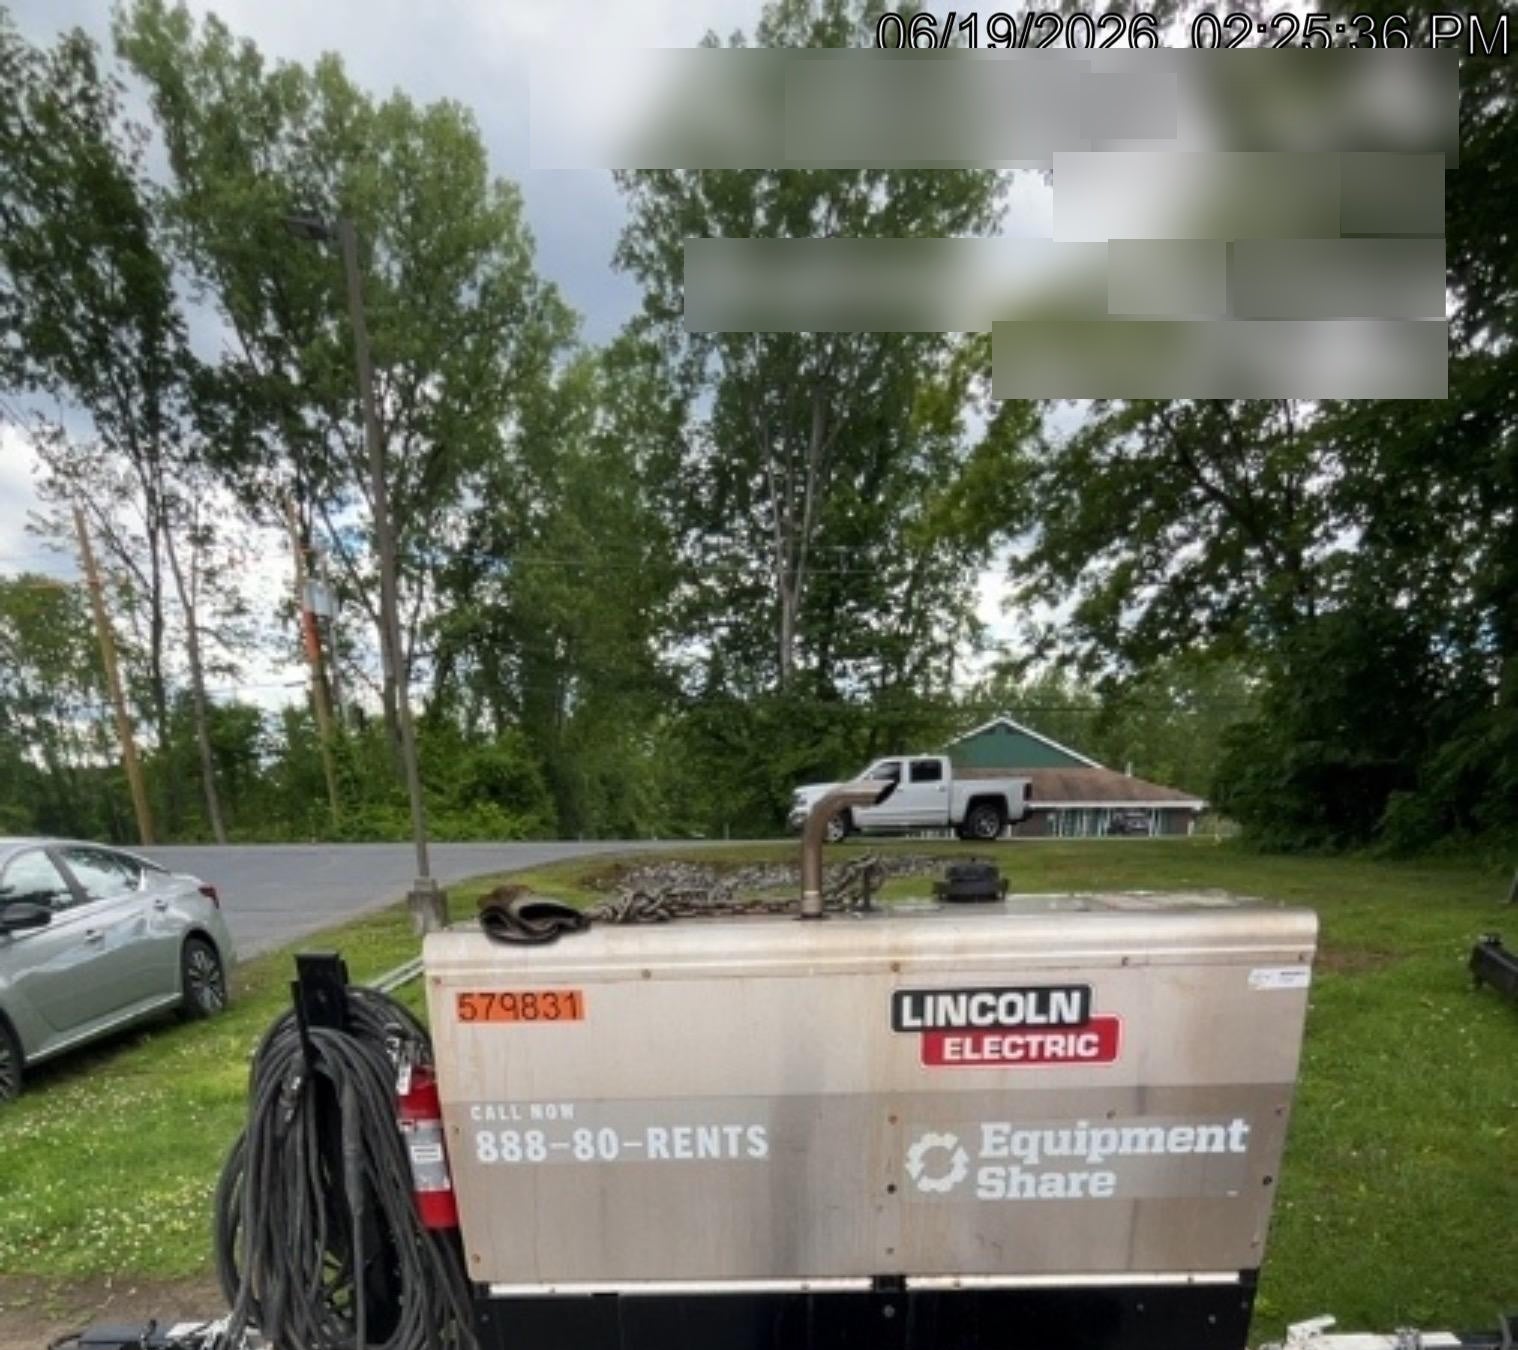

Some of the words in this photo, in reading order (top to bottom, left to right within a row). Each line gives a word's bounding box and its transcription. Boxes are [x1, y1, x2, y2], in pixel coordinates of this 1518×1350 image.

[457, 992, 578, 1021] 579831
[901, 989, 1082, 1028] LINCOLN
[941, 1033, 1099, 1061] ELECTRIC
[470, 1104, 522, 1121] CALL
[530, 1102, 575, 1120] NOW
[475, 1124, 769, 1163] 888-80-RENTS
[979, 1117, 1250, 1165] Equipment
[976, 1163, 1117, 1199] Share
